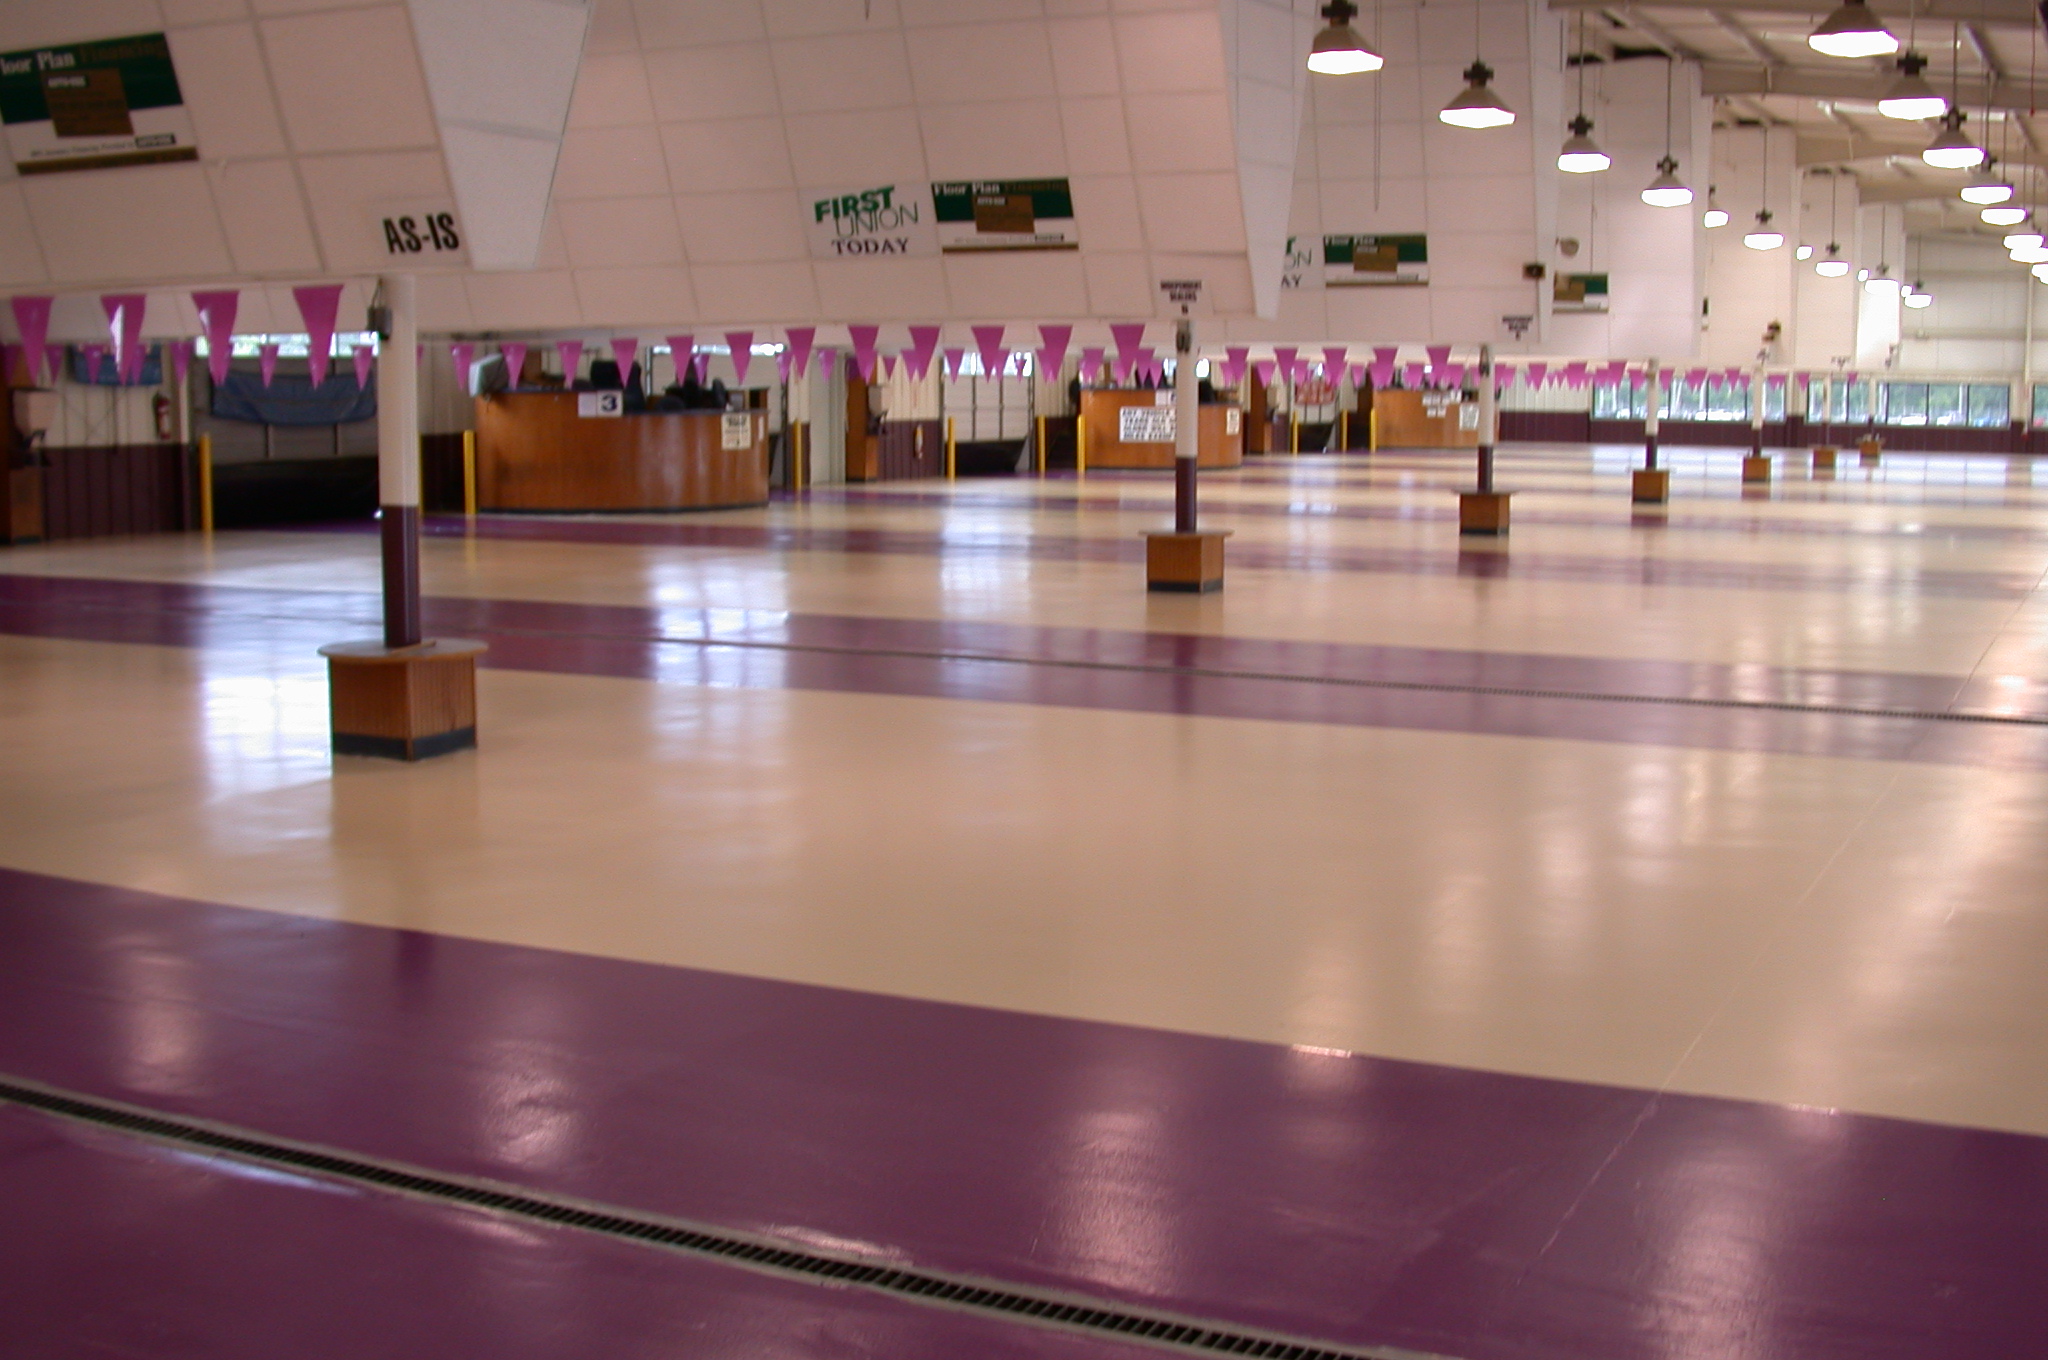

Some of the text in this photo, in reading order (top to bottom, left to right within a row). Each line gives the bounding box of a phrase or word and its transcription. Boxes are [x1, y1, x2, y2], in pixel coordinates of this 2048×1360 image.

[0, 56, 32, 75] loor
[37, 50, 76, 71] Plan
[932, 183, 968, 196] Floor
[972, 182, 1000, 195] Plan
[815, 187, 894, 222] FIRST
[835, 202, 918, 237] UNION
[382, 211, 460, 256] AS-IS
[832, 238, 909, 256] TODAY
[602, 395, 617, 411] 3
